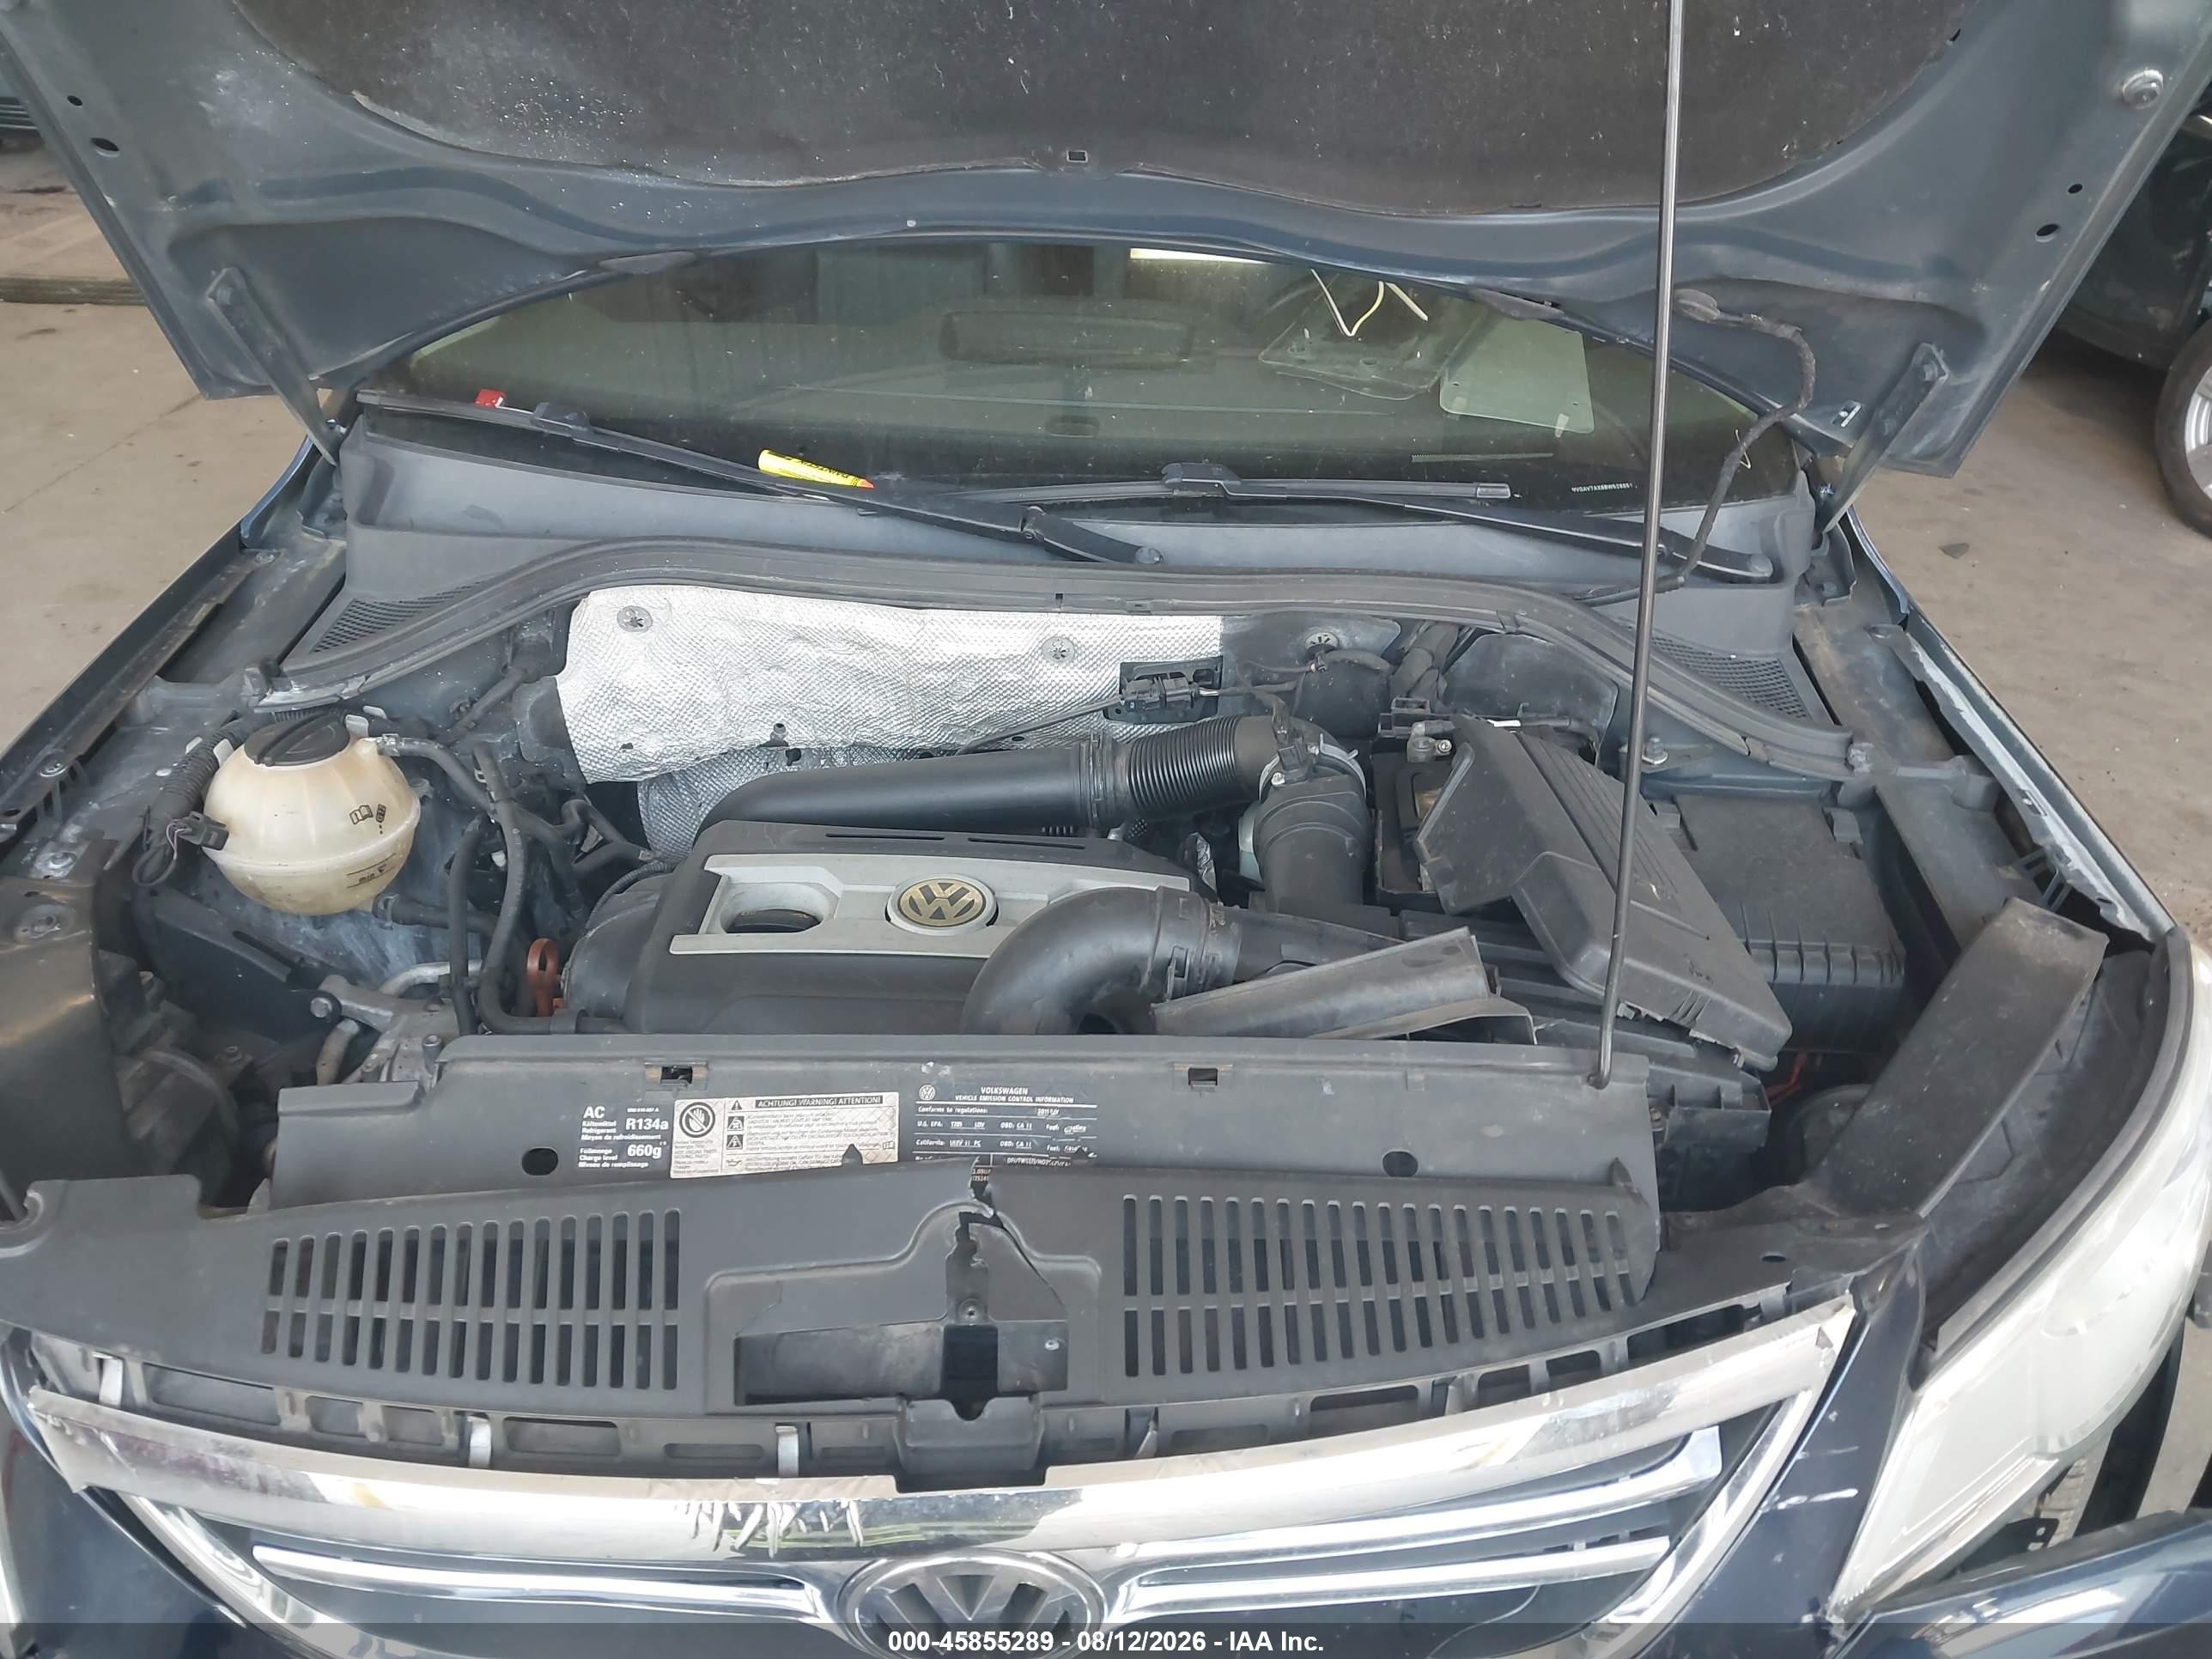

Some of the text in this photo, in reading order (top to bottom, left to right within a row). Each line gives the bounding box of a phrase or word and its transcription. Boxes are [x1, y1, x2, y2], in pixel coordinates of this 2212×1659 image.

[359, 872, 376, 884] min
[981, 1086, 1029, 1095] VOLKSWAGEN
[757, 1095, 881, 1108] ACHTUNG! WARNING! ATTENTION!
[583, 1106, 605, 1119] AC
[626, 1118, 669, 1130] R134a
[628, 1144, 662, 1159] 660g
